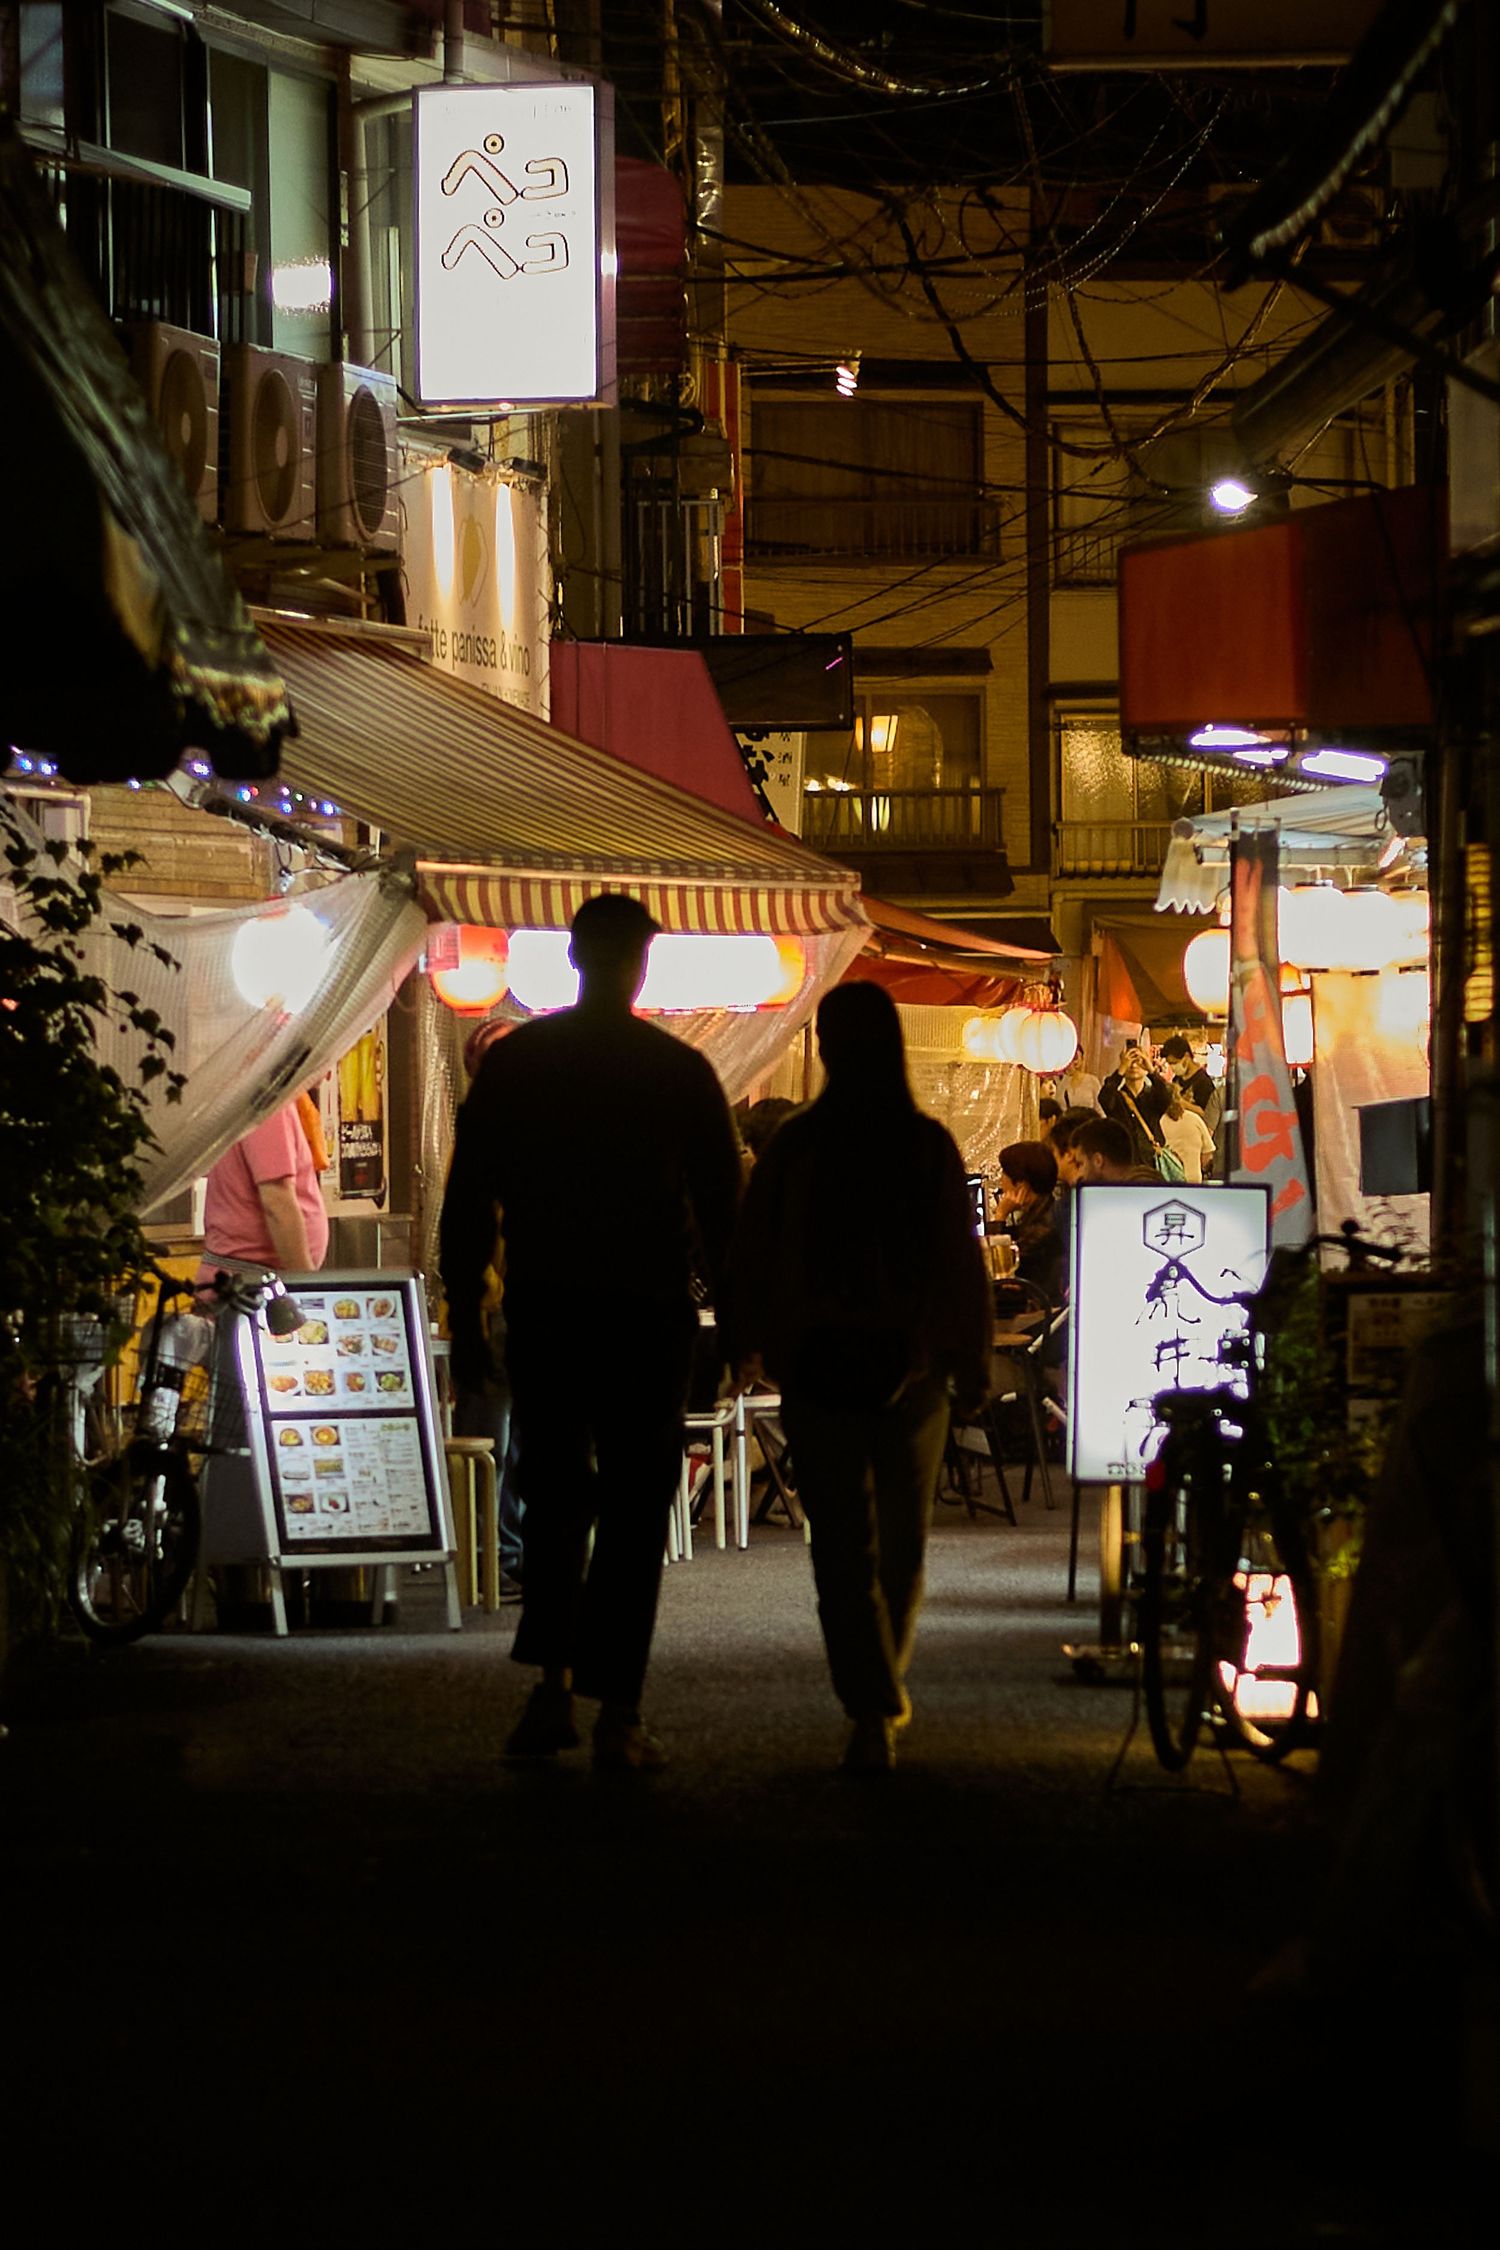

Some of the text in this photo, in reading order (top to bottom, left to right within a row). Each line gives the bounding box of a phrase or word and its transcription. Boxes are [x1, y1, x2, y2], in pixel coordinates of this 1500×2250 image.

[441, 133, 569, 206] ペコ
[441, 207, 569, 280] ペコ
[418, 613, 447, 660] tte
[452, 623, 497, 670] panissa
[508, 632, 531, 677] vino
[1154, 1212, 1195, 1246] 昇
